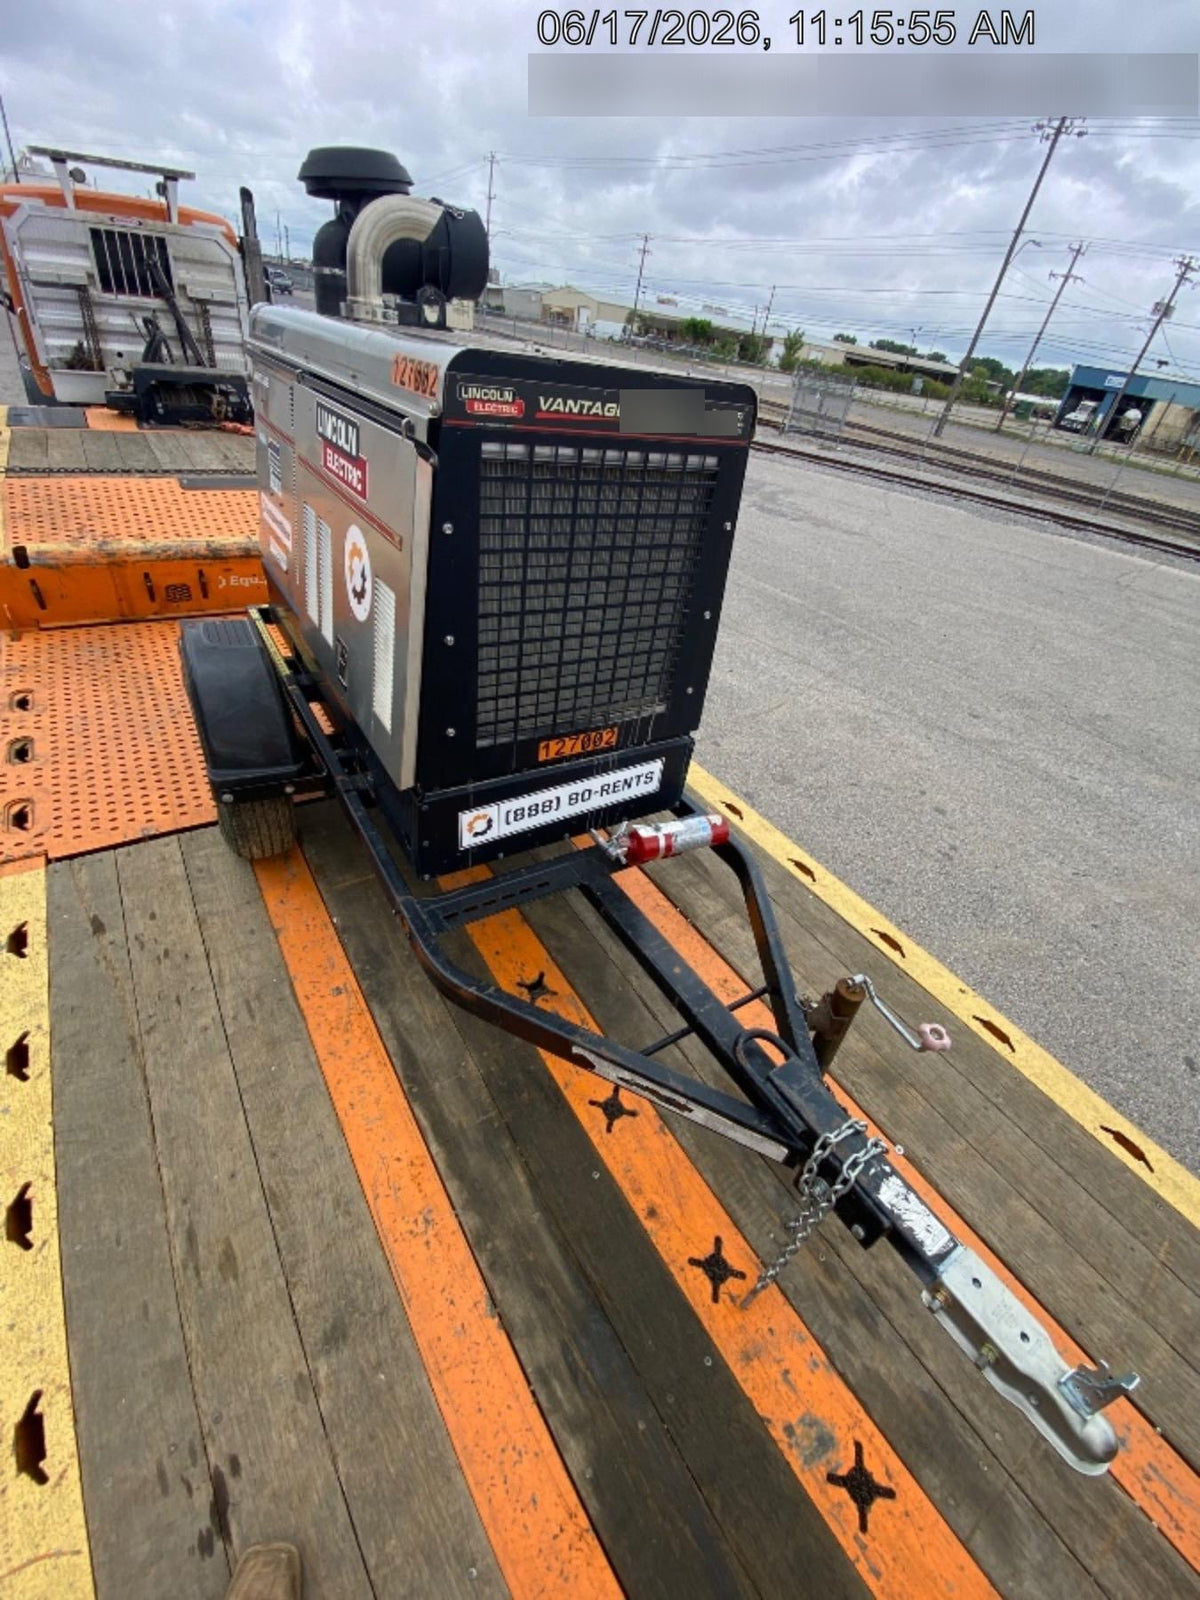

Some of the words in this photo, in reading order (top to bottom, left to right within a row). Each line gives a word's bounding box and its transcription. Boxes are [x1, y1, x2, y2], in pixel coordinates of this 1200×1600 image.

[461, 387, 513, 402] LINCOLN
[474, 401, 518, 414] ELECTRIC
[317, 406, 357, 456] LINCOLN
[326, 447, 362, 491] ELECTRIC
[541, 728, 616, 758] 127002
[505, 796, 561, 826] (888)
[568, 770, 655, 806] 80-RENTS
